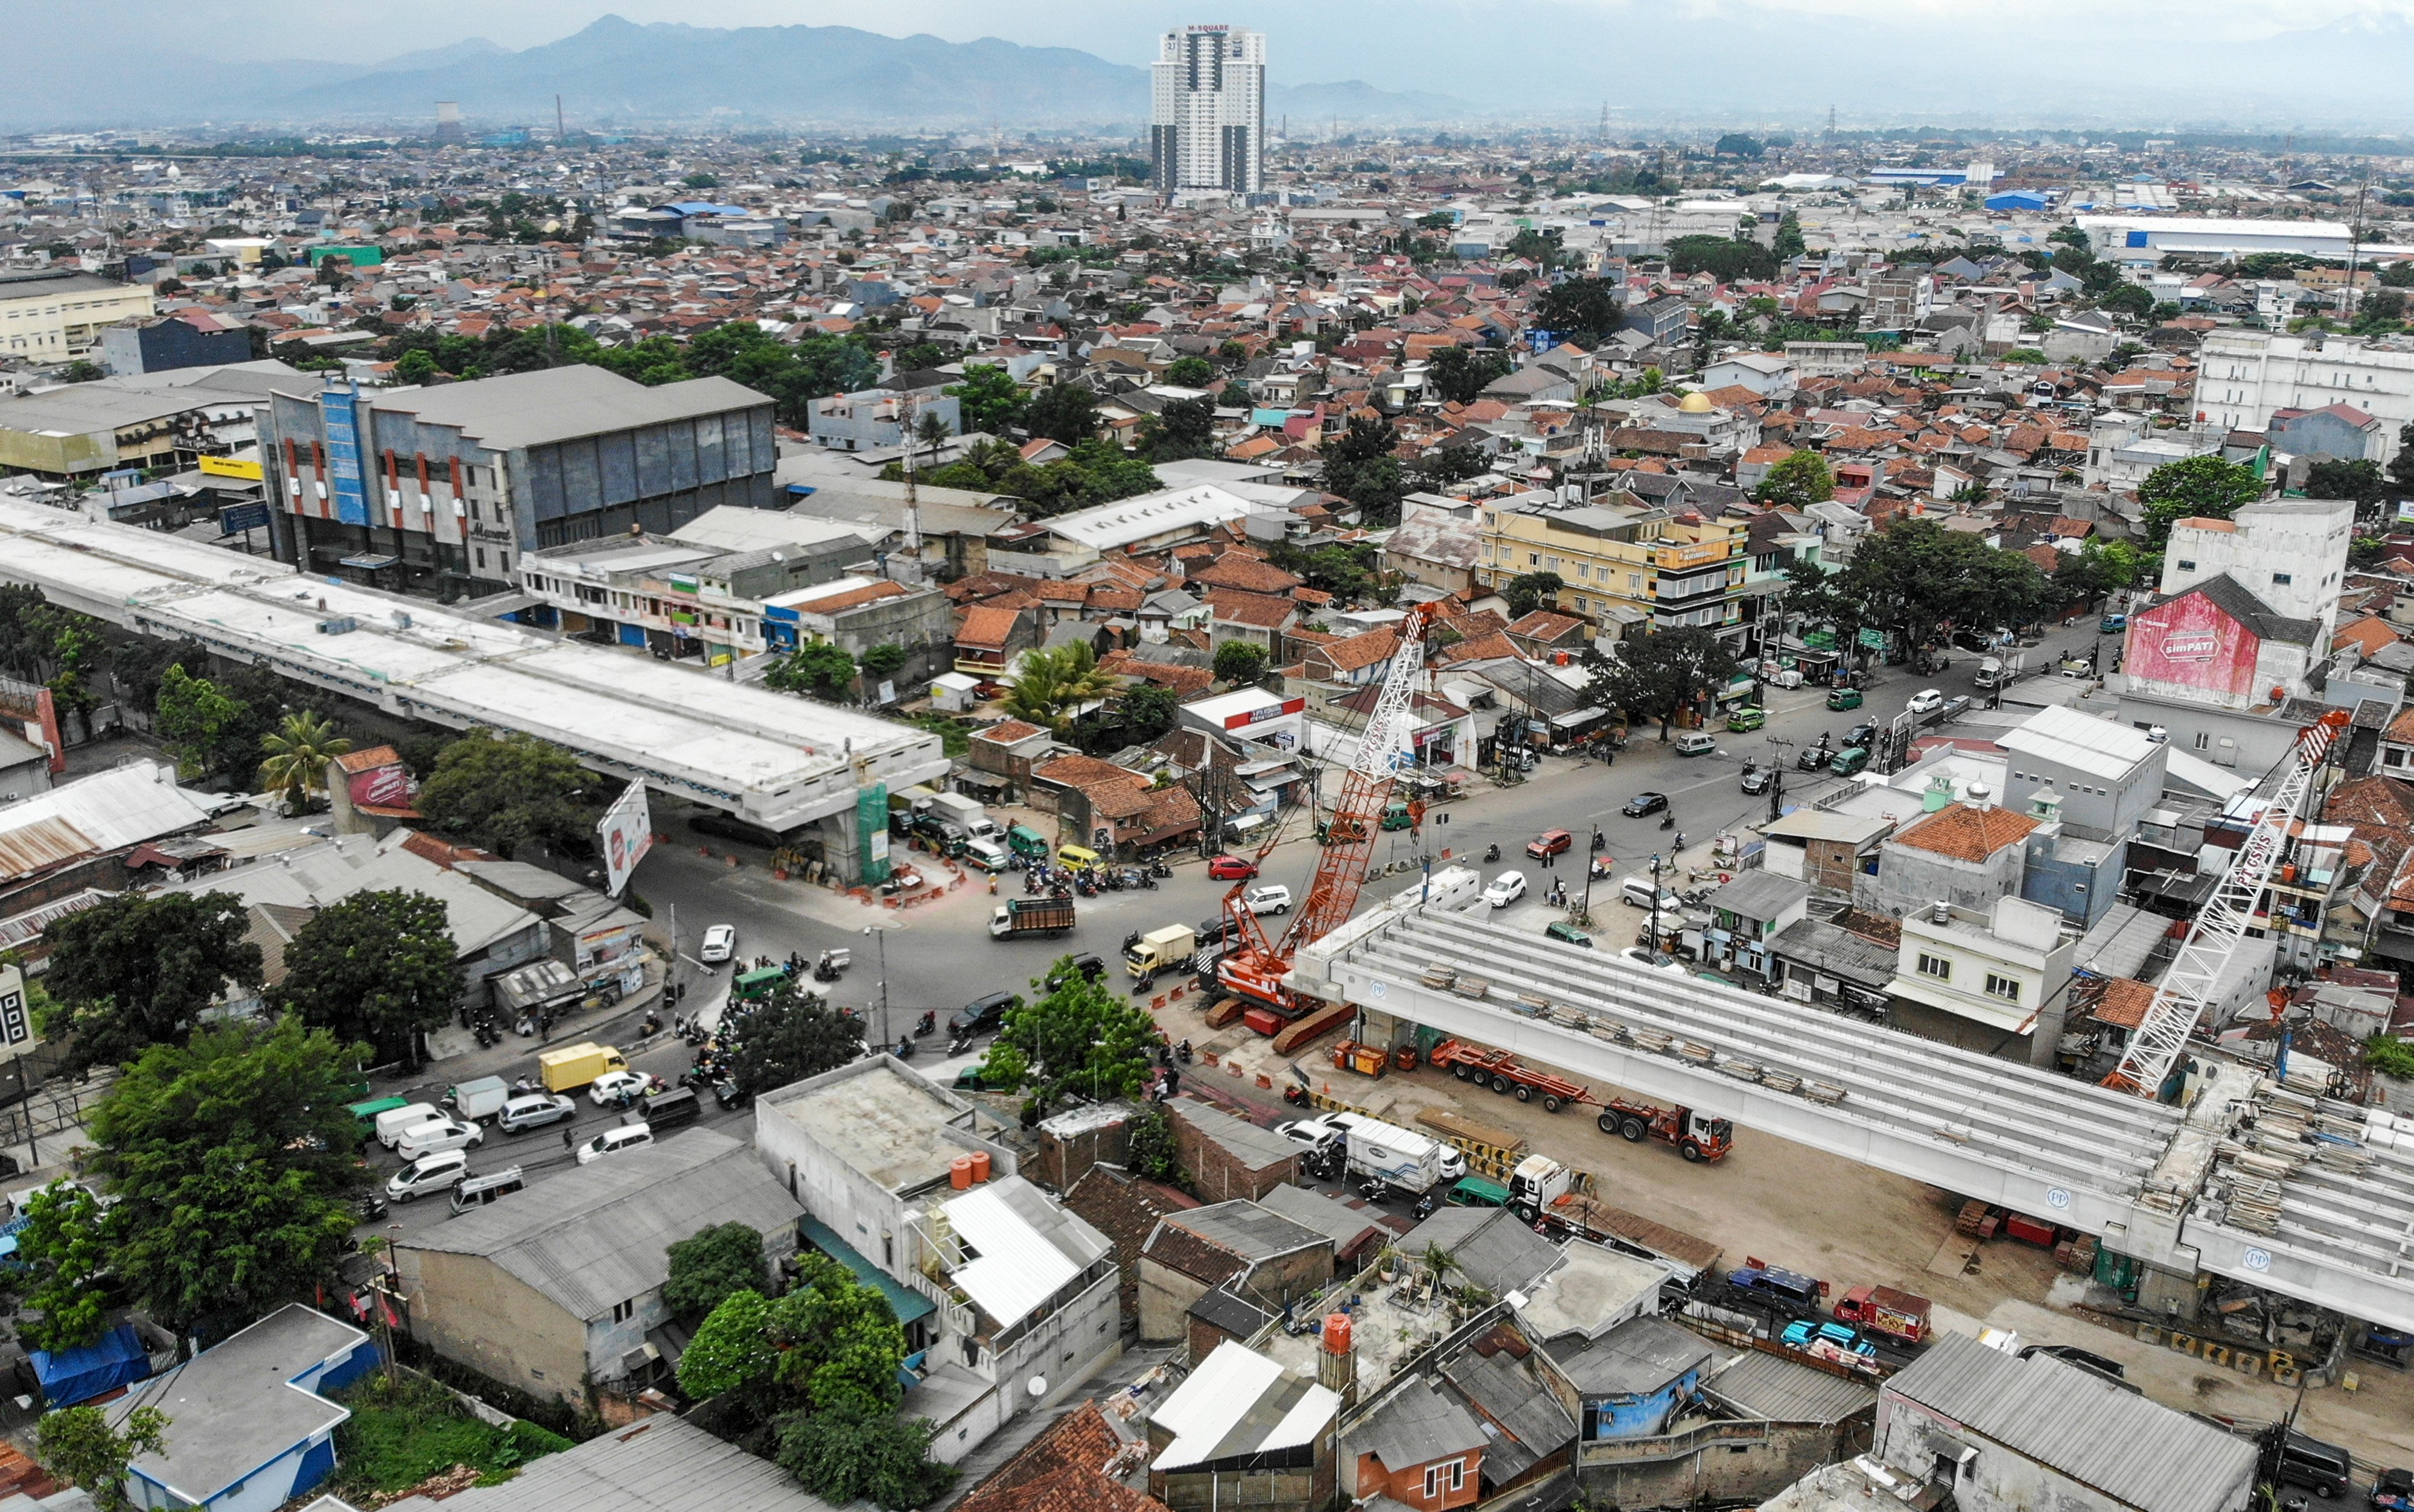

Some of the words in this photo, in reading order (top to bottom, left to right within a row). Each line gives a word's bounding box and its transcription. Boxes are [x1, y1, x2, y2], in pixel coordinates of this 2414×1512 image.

[2165, 641, 2213, 653] simPATI
[1364, 745, 1375, 760] PT
[2237, 868, 2253, 886] PT
